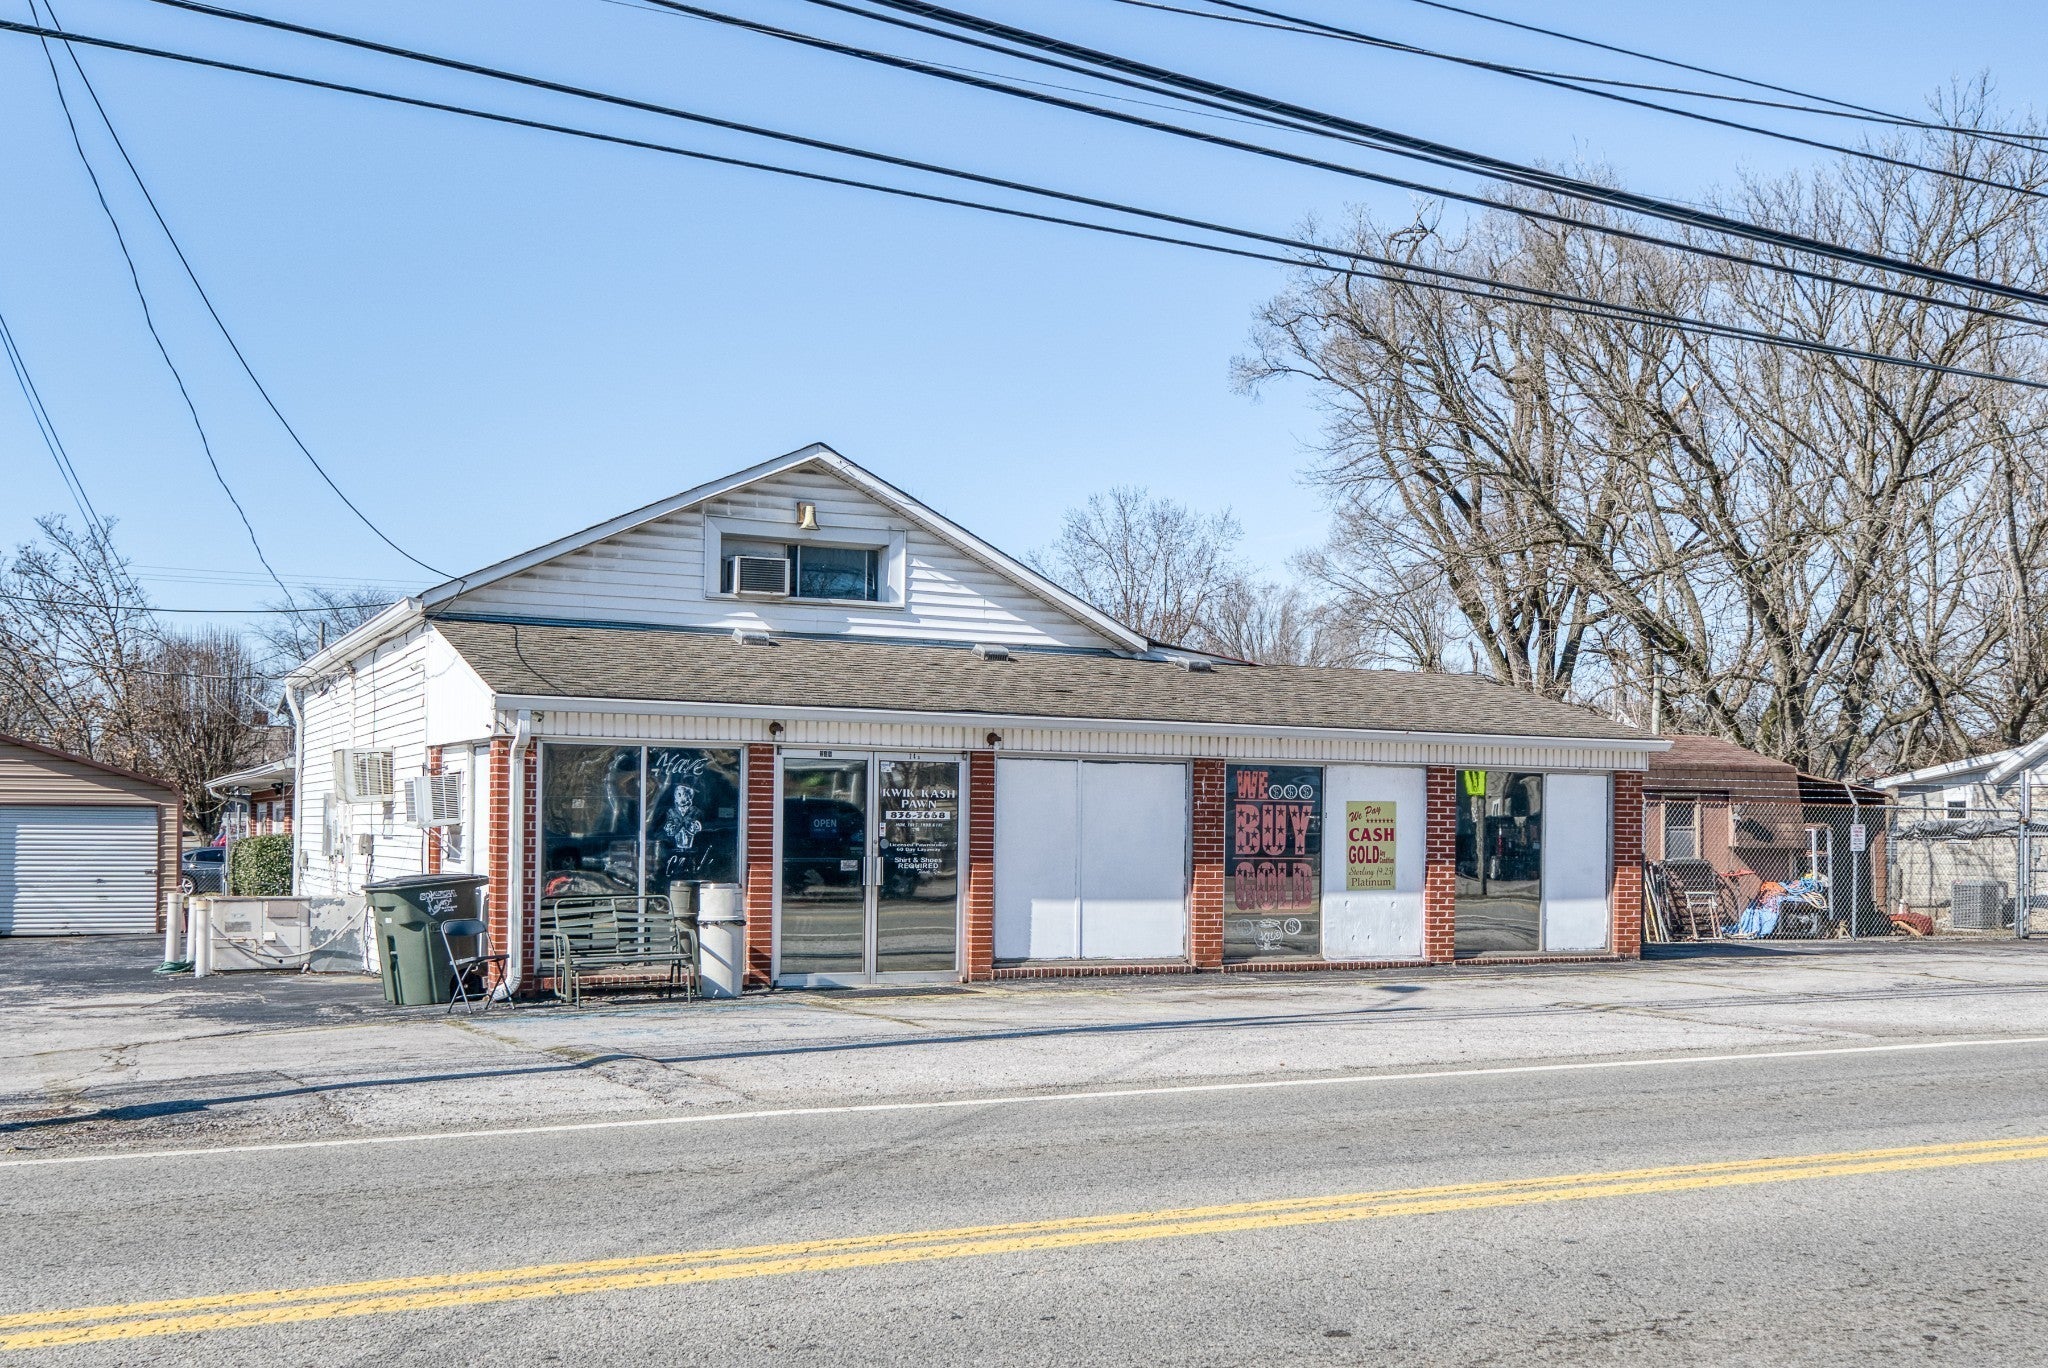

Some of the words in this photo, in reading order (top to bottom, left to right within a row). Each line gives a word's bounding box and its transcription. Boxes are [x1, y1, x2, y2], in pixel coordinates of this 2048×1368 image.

[651, 752, 708, 776] Have
[1236, 770, 1268, 799] WE
[882, 788, 914, 798] KWIK
[921, 789, 956, 799] KASH
[901, 799, 937, 809] PAWN
[1348, 811, 1363, 822] We
[1364, 805, 1381, 817] Pay
[813, 819, 837, 828] OPEN
[1235, 804, 1313, 855] BUY
[1348, 827, 1395, 842] CASH
[1348, 845, 1380, 864] GOLD
[897, 862, 939, 870] REQUIRED
[1235, 861, 1313, 910] GOLD
[1351, 877, 1392, 887] Platinum
